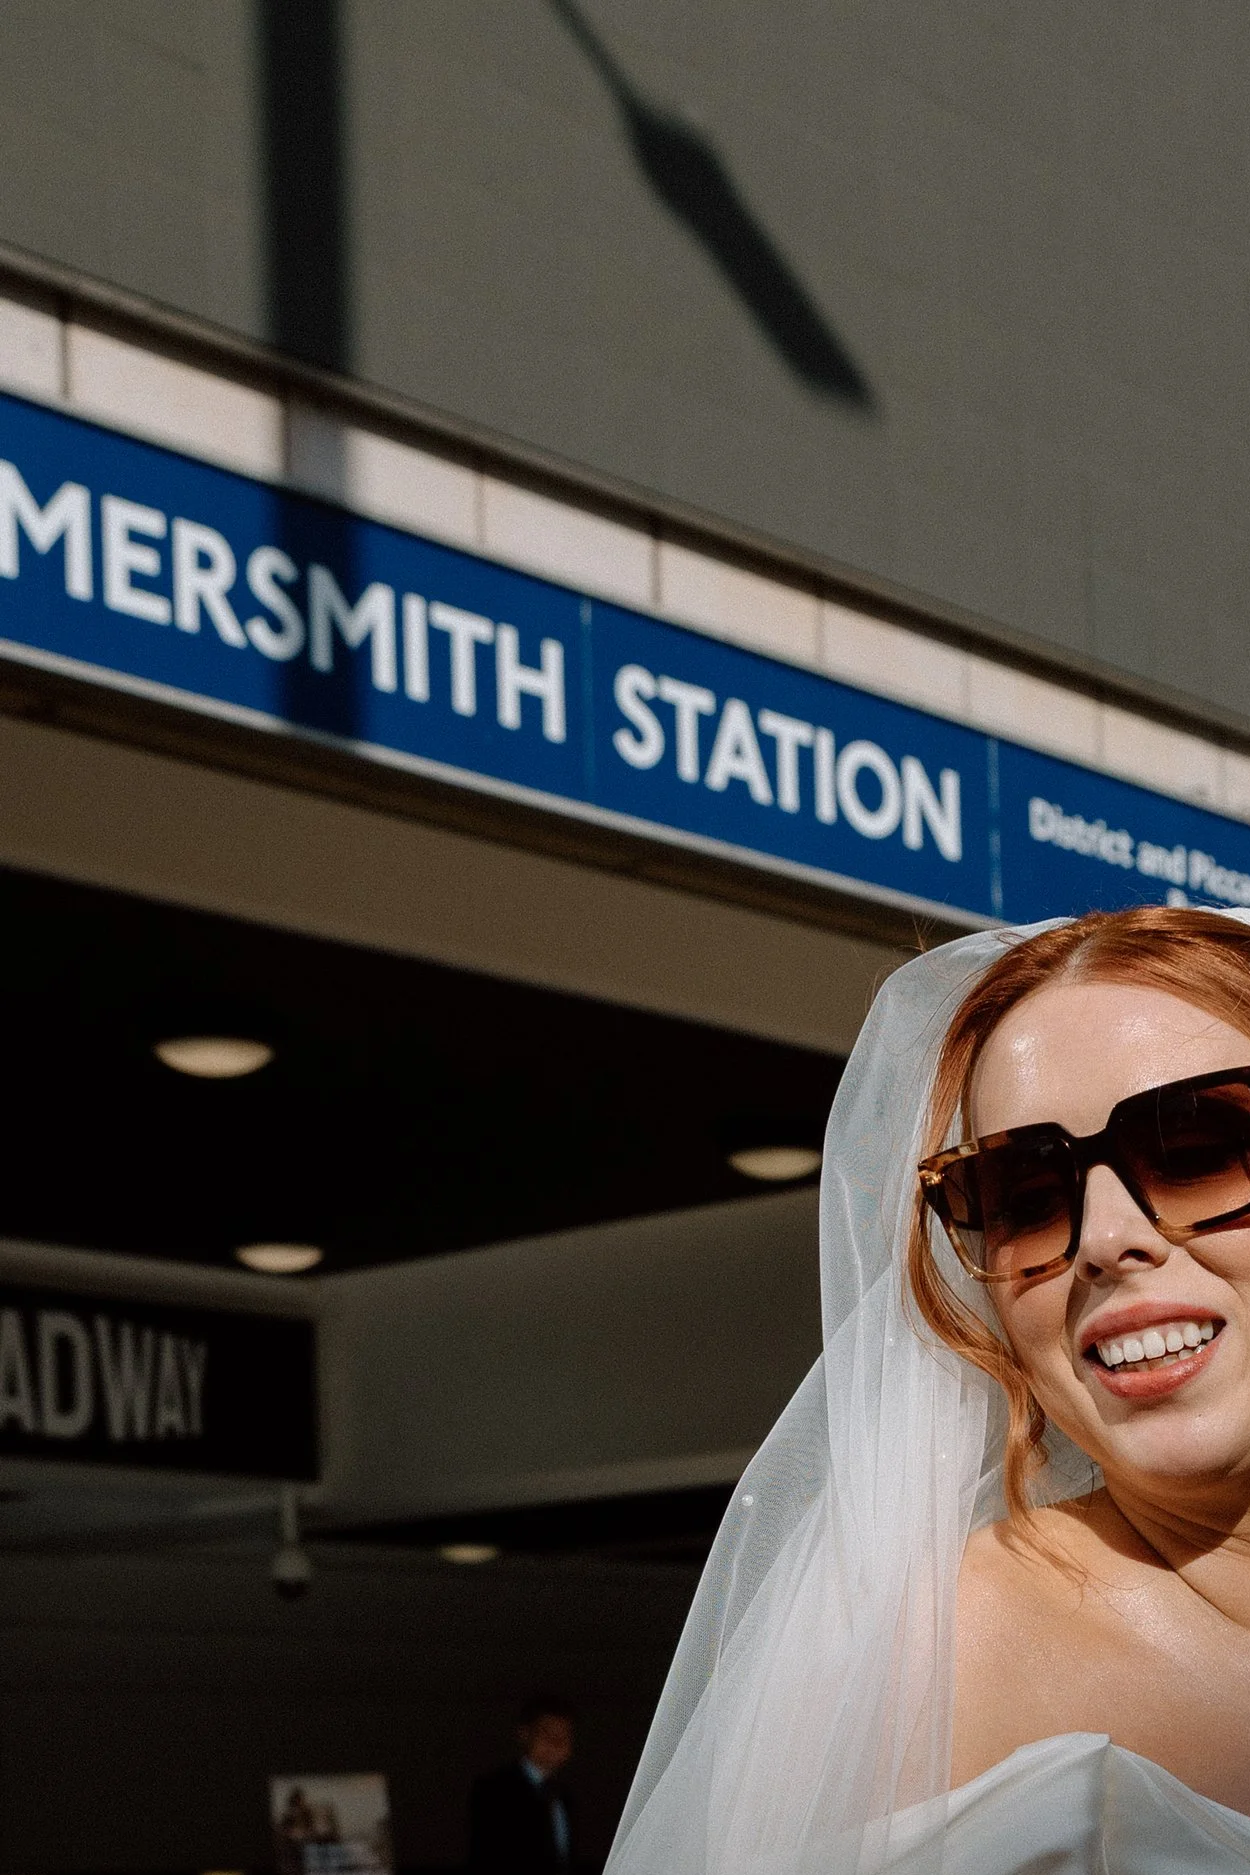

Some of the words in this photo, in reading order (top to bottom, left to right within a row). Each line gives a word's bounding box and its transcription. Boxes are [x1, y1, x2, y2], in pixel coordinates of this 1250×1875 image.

[0, 457, 567, 743] MERSMITH
[613, 664, 962, 862] STATION
[1028, 797, 1135, 869] District
[1137, 841, 1188, 886] and
